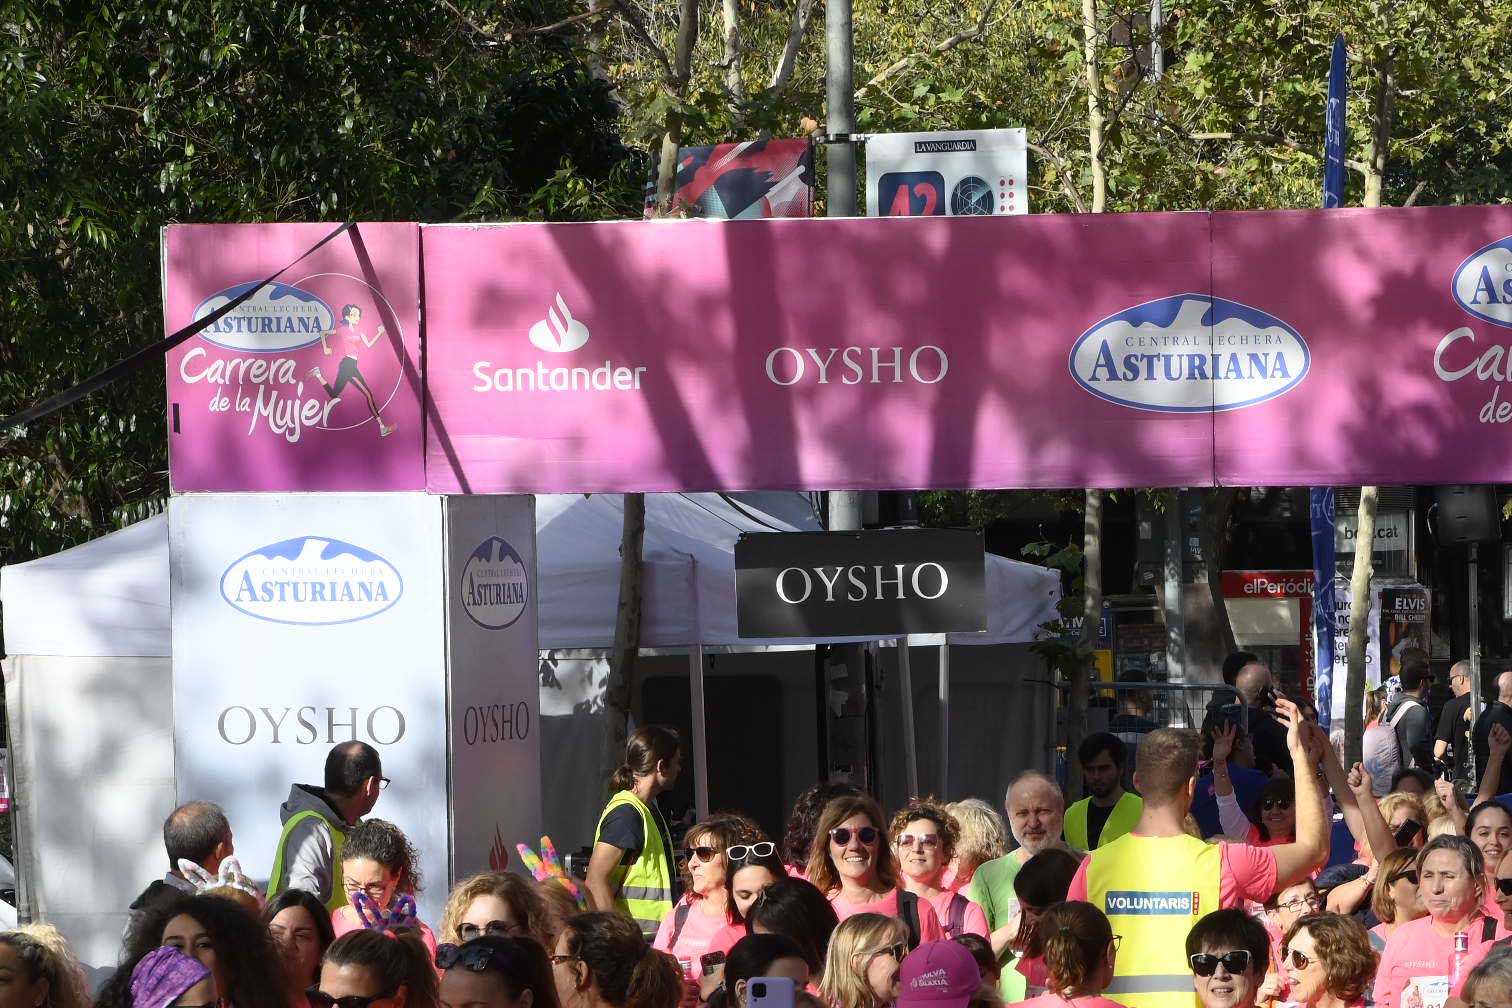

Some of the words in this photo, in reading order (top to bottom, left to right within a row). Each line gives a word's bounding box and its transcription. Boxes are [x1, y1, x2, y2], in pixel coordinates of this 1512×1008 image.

[926, 141, 975, 151] VANGUARDIA
[202, 306, 323, 335] ASTURIANA
[273, 302, 320, 313] LECHERA
[1125, 335, 1201, 348] CENTRAL
[1208, 335, 1284, 346] LECHERA
[180, 348, 297, 385] Carrera
[472, 361, 647, 392] Santander
[764, 345, 949, 386] OYSHO
[1087, 339, 1291, 382] ASTURIANA
[208, 393, 231, 413] de
[234, 392, 252, 413] la
[248, 381, 342, 442] Mujer
[1480, 387, 1512, 423] de
[236, 569, 389, 602] ASTURIANA
[466, 571, 525, 607] ASTURIANA
[776, 562, 949, 604] OYSHO
[1395, 597, 1425, 610] ELVIS
[217, 705, 406, 745] OYSHO
[463, 701, 530, 745] OYSHO
[1108, 897, 1189, 910] VOLUNTARIS
